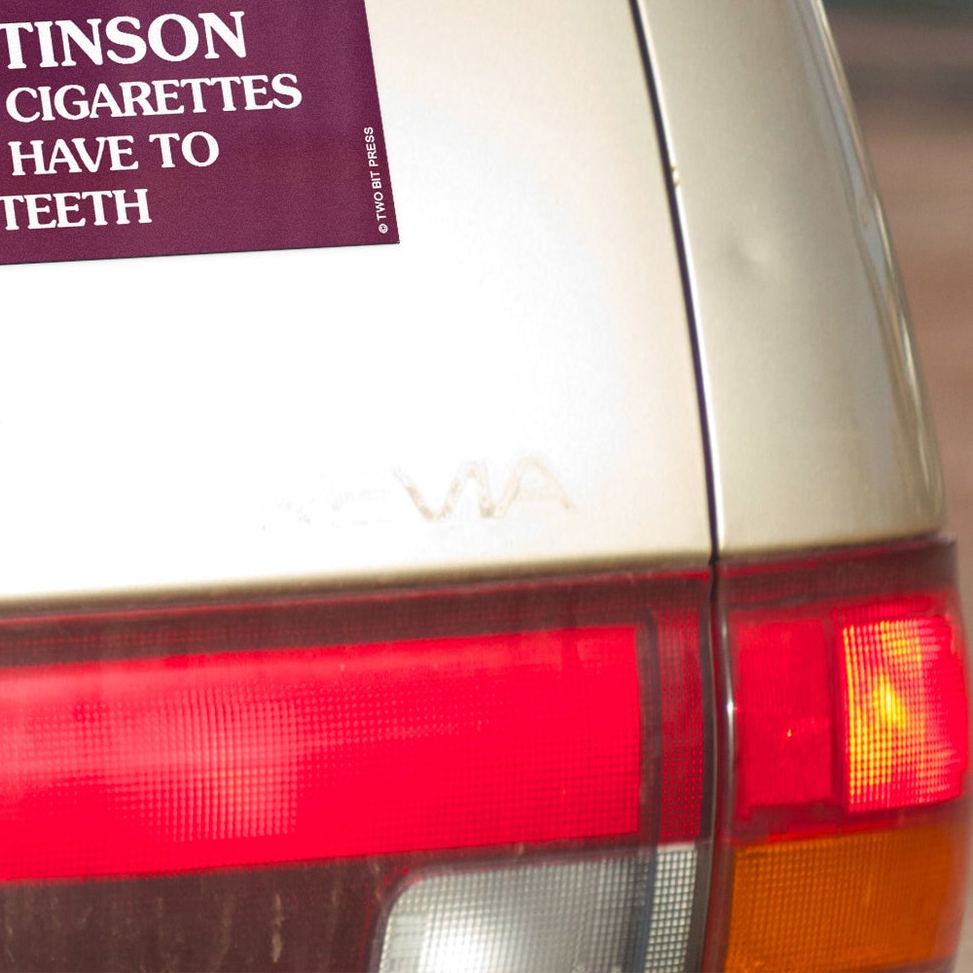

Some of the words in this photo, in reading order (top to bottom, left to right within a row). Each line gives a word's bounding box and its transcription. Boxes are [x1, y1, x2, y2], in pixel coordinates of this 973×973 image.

[5, 73, 303, 123] CIGARETTES
[7, 134, 139, 176] HAVE
[148, 131, 220, 169] TO
[364, 126, 378, 167] PRESS
[370, 170, 382, 189] BIT
[373, 191, 386, 220] TWO
